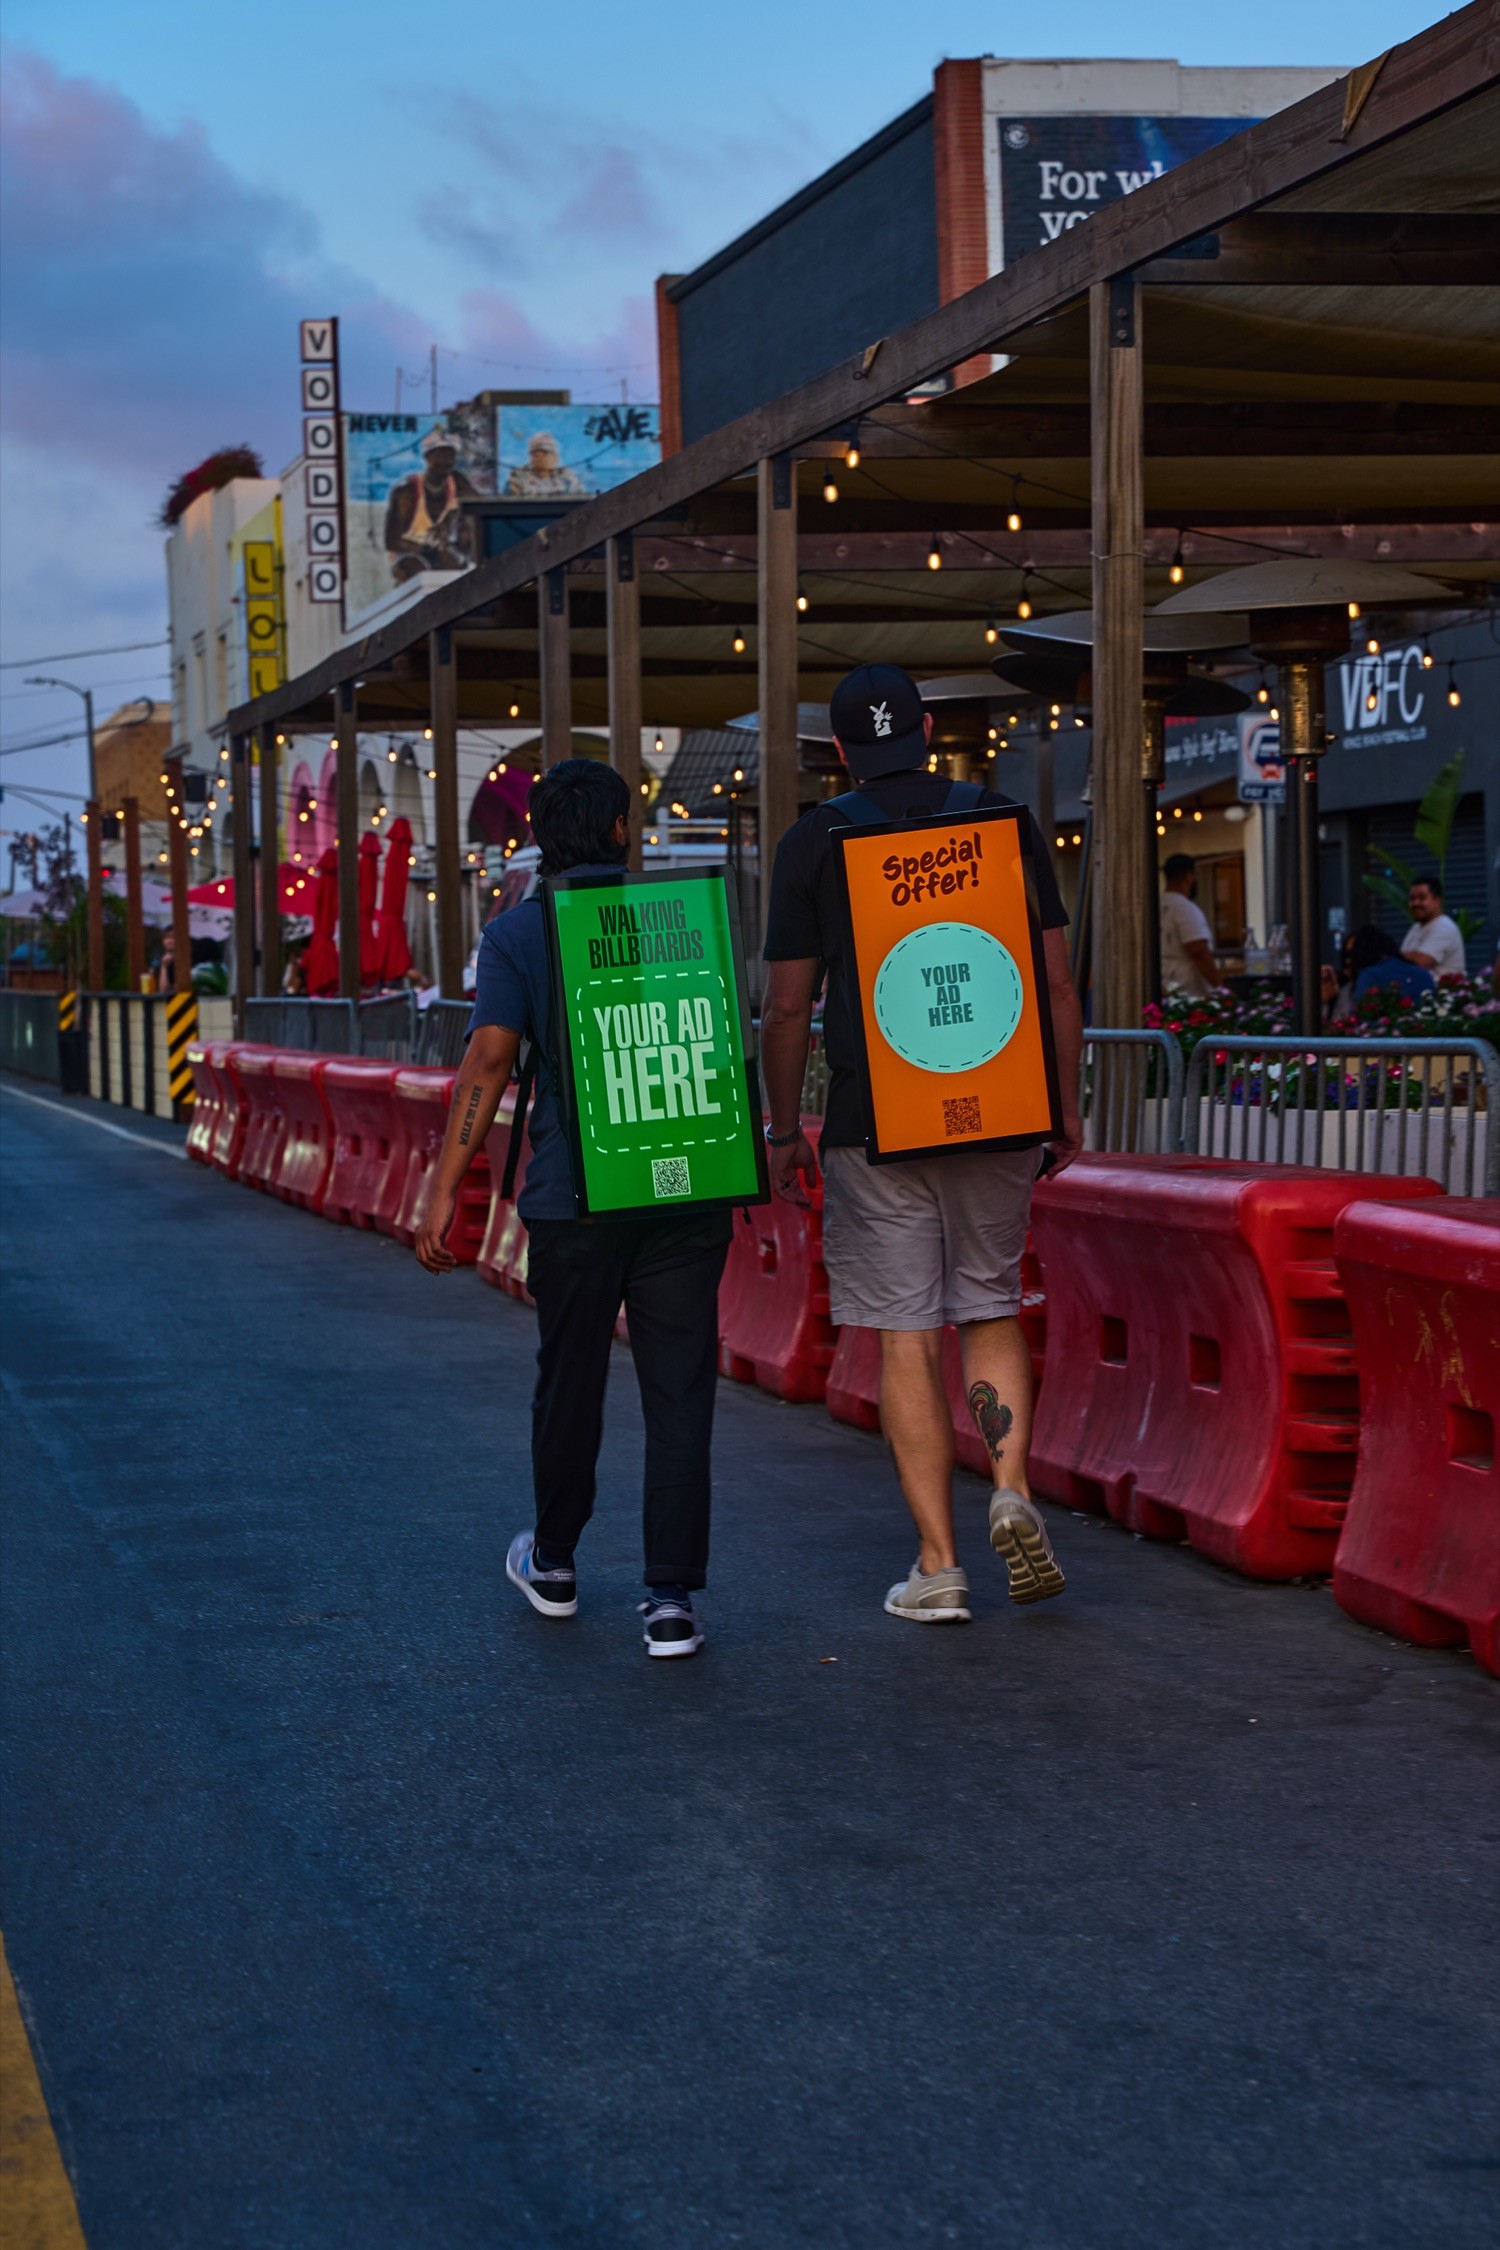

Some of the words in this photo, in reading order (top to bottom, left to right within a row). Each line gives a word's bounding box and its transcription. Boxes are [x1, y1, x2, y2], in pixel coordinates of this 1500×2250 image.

[1038, 161, 1108, 200] For
[350, 415, 418, 432] NEVER
[308, 329, 337, 593] VOODOO
[1339, 645, 1425, 732] VBFC
[882, 832, 983, 883] Special
[891, 861, 980, 906] Offer!
[597, 899, 687, 936] WALKING
[588, 929, 705, 969] BILLBOARDS
[920, 963, 971, 988] YOUR
[928, 1003, 974, 1027] HERE
[937, 985, 961, 1006] AD
[593, 1001, 670, 1050] YOUR
[678, 997, 714, 1043] AD
[602, 1041, 722, 1125] HERE
[458, 1120, 474, 1147] WALK
